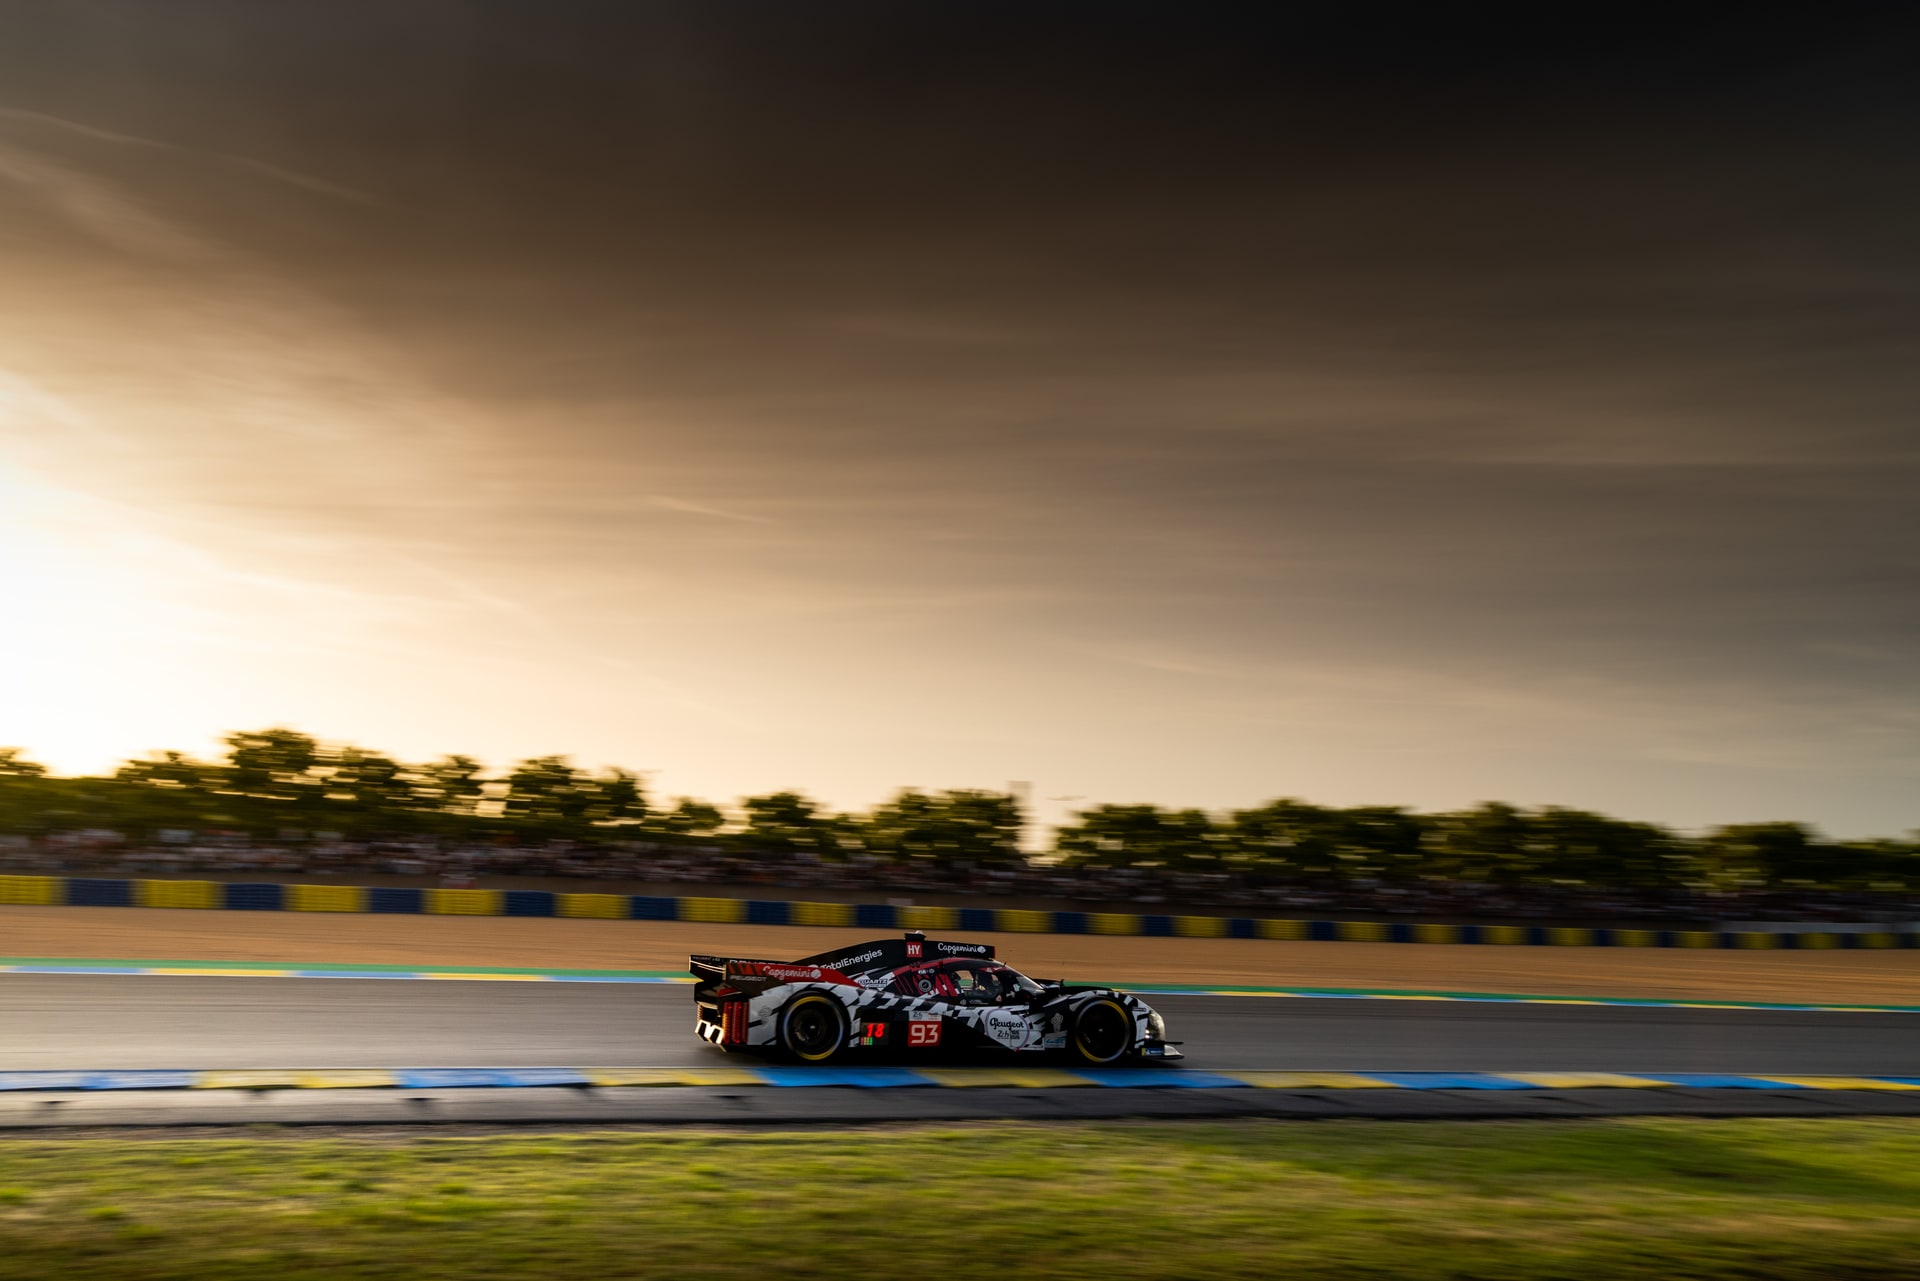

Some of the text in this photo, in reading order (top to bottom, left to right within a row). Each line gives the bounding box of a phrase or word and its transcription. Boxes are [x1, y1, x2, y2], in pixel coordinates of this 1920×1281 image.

[907, 944, 921, 955] HY
[937, 942, 977, 955] Capgemini
[729, 974, 767, 982] PEUGEOT
[762, 965, 811, 981] Capgemini
[990, 1017, 1024, 1030] Peugeot
[866, 1023, 885, 1039] 18
[910, 1024, 939, 1044] 93
